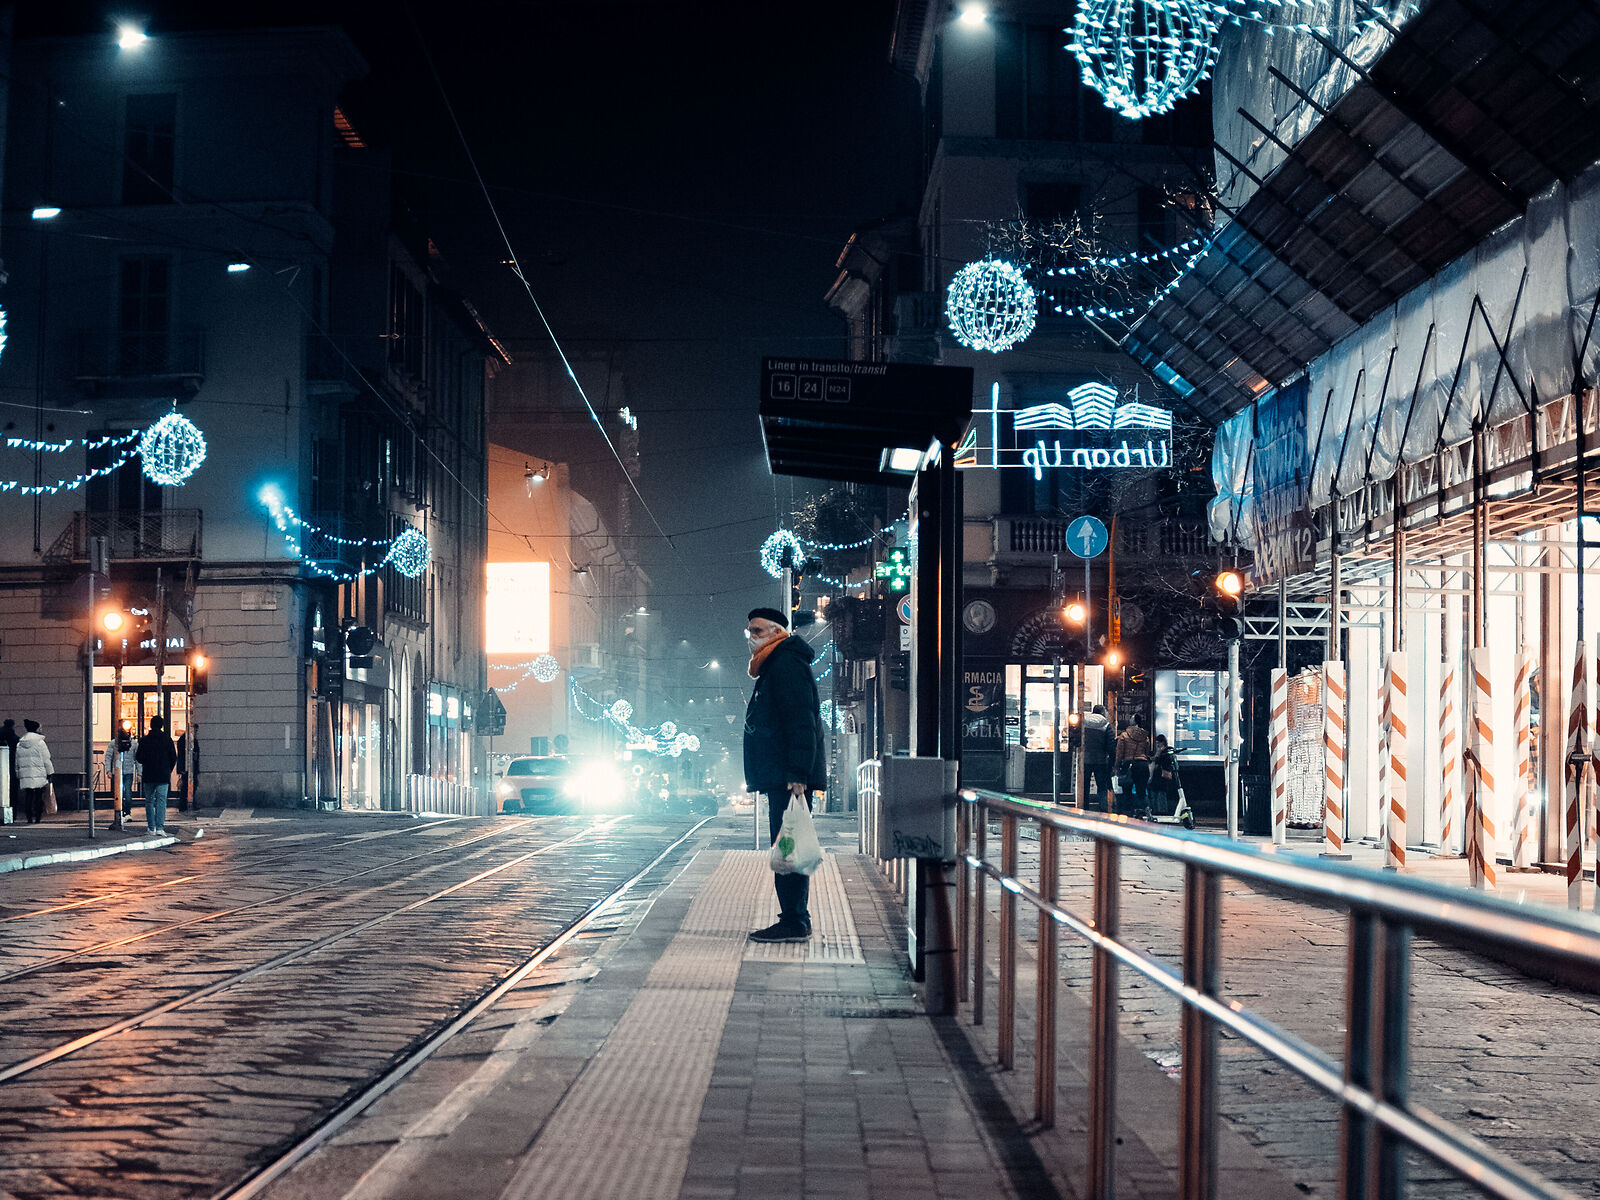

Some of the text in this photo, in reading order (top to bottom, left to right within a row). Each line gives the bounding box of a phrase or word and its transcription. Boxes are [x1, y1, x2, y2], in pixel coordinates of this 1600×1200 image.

[768, 359, 796, 371] Linee
[799, 361, 809, 372] in
[777, 381, 791, 392] 16
[803, 382, 818, 394] 24
[962, 671, 1002, 684] RMACIA
